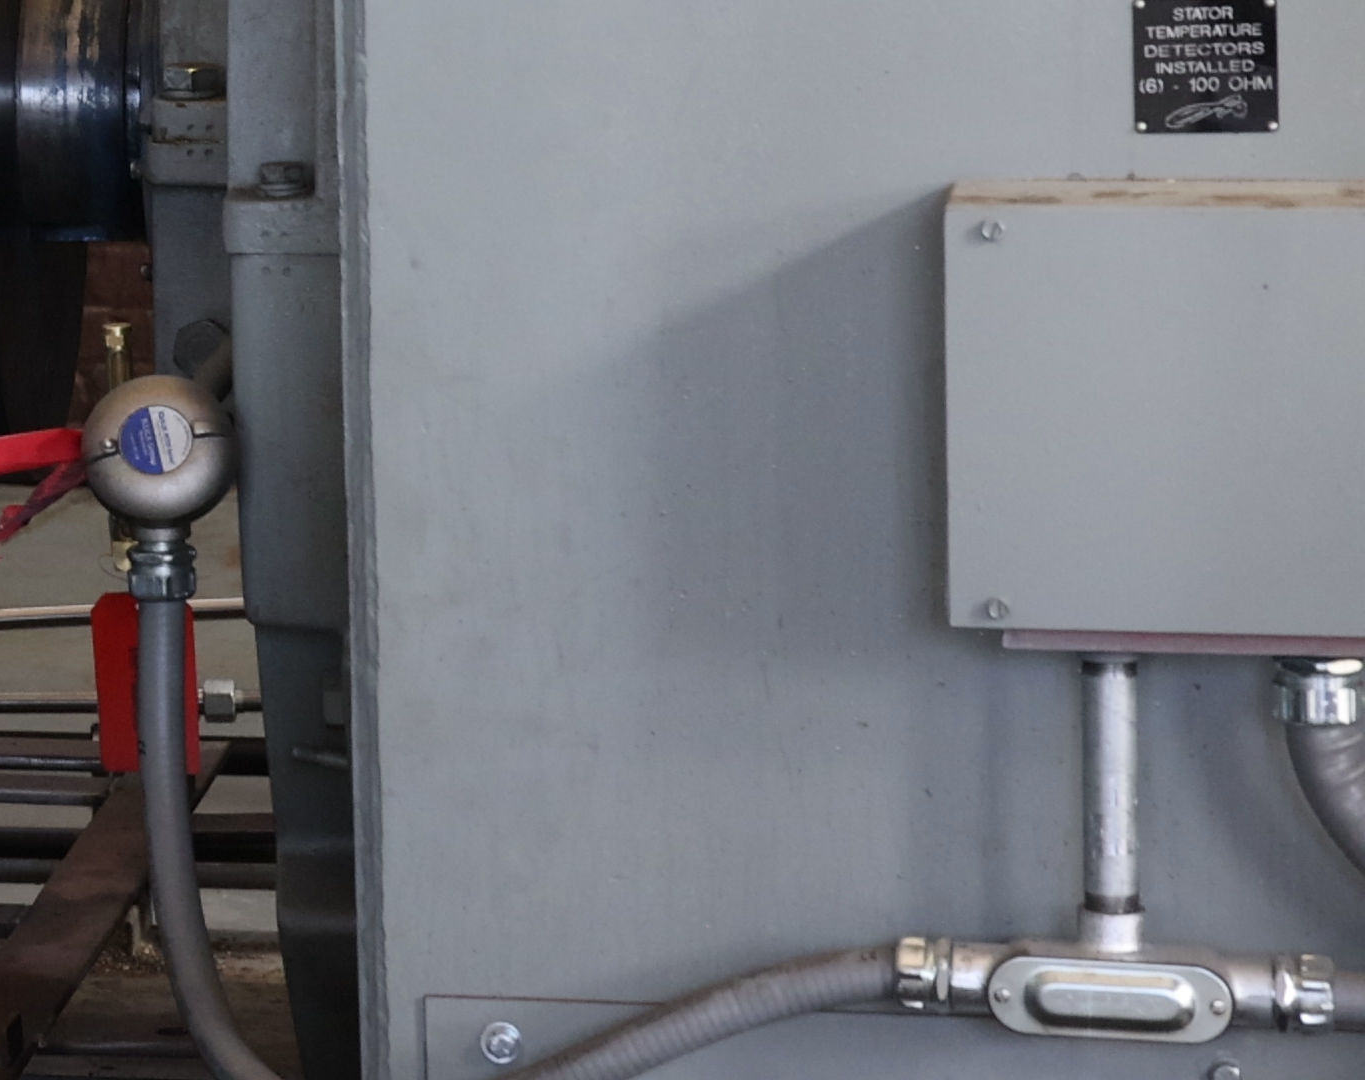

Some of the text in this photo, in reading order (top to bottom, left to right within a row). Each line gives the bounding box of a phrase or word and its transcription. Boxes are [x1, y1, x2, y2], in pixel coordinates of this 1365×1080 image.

[1172, 6, 1234, 21] STATOR
[1146, 23, 1263, 39] TEMPERATURE
[1144, 41, 1265, 58] DETECTORS
[1155, 59, 1255, 74] INSTALLED
[1138, 78, 1164, 94] (6)
[1189, 77, 1220, 93] 100
[1228, 75, 1273, 91] OHM
